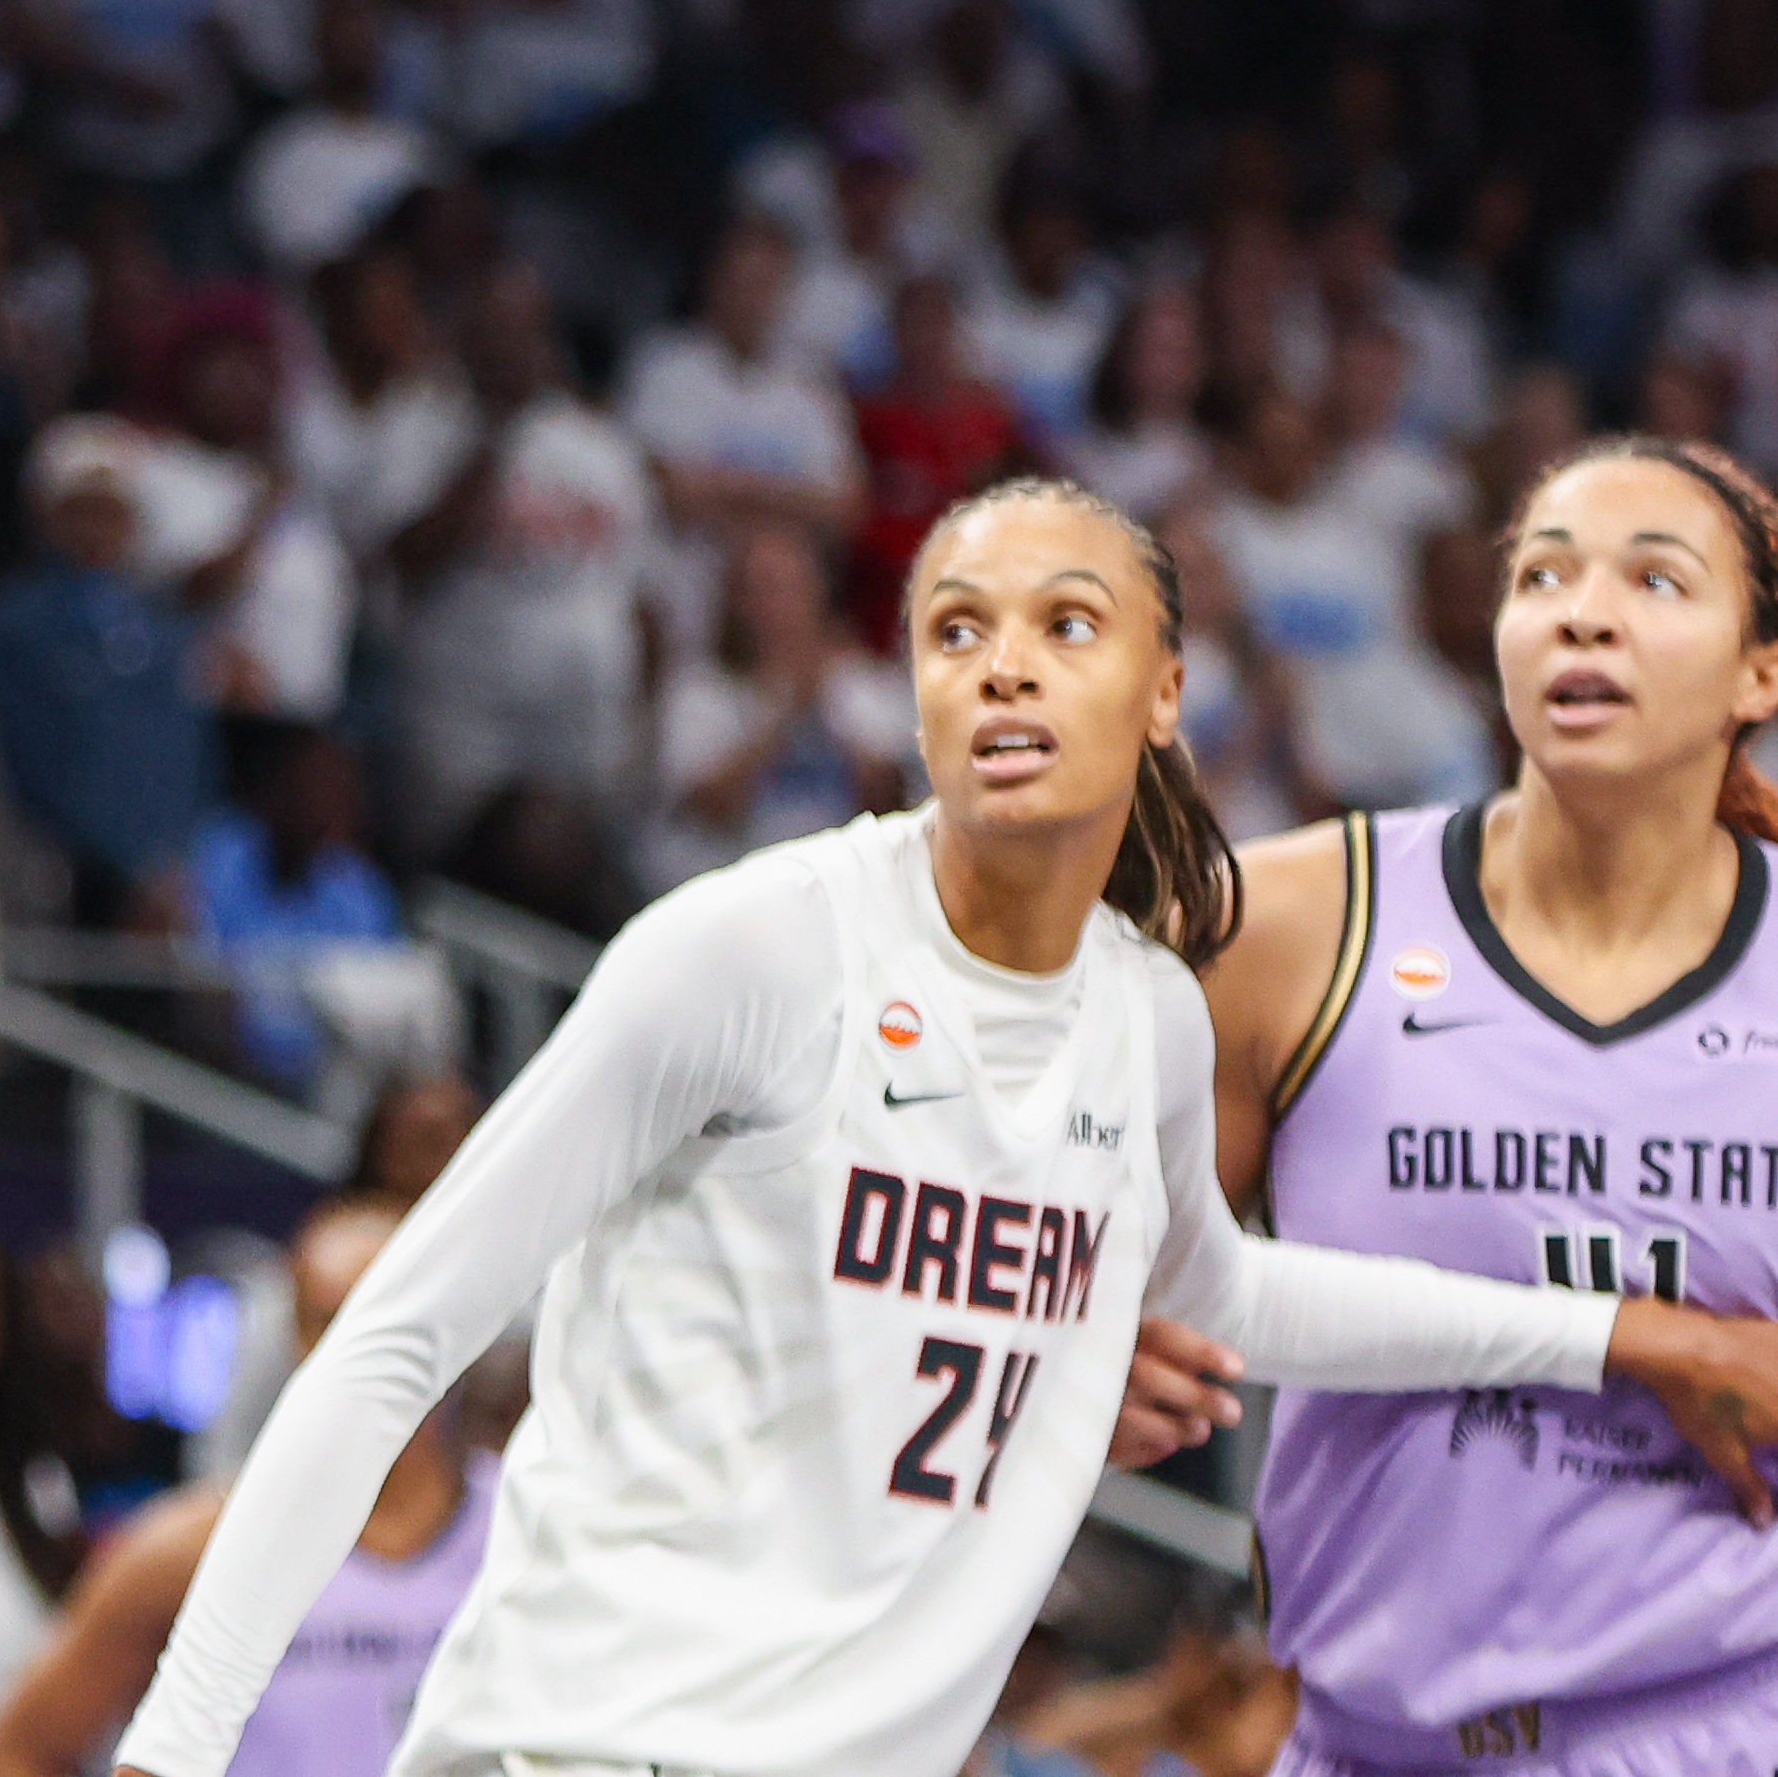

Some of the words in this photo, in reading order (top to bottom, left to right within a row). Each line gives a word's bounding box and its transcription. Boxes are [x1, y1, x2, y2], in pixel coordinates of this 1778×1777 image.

[1387, 1123, 1607, 1196] GOLDEN
[833, 1165, 1112, 1324] DREAM
[887, 1334, 1041, 1515] 24
